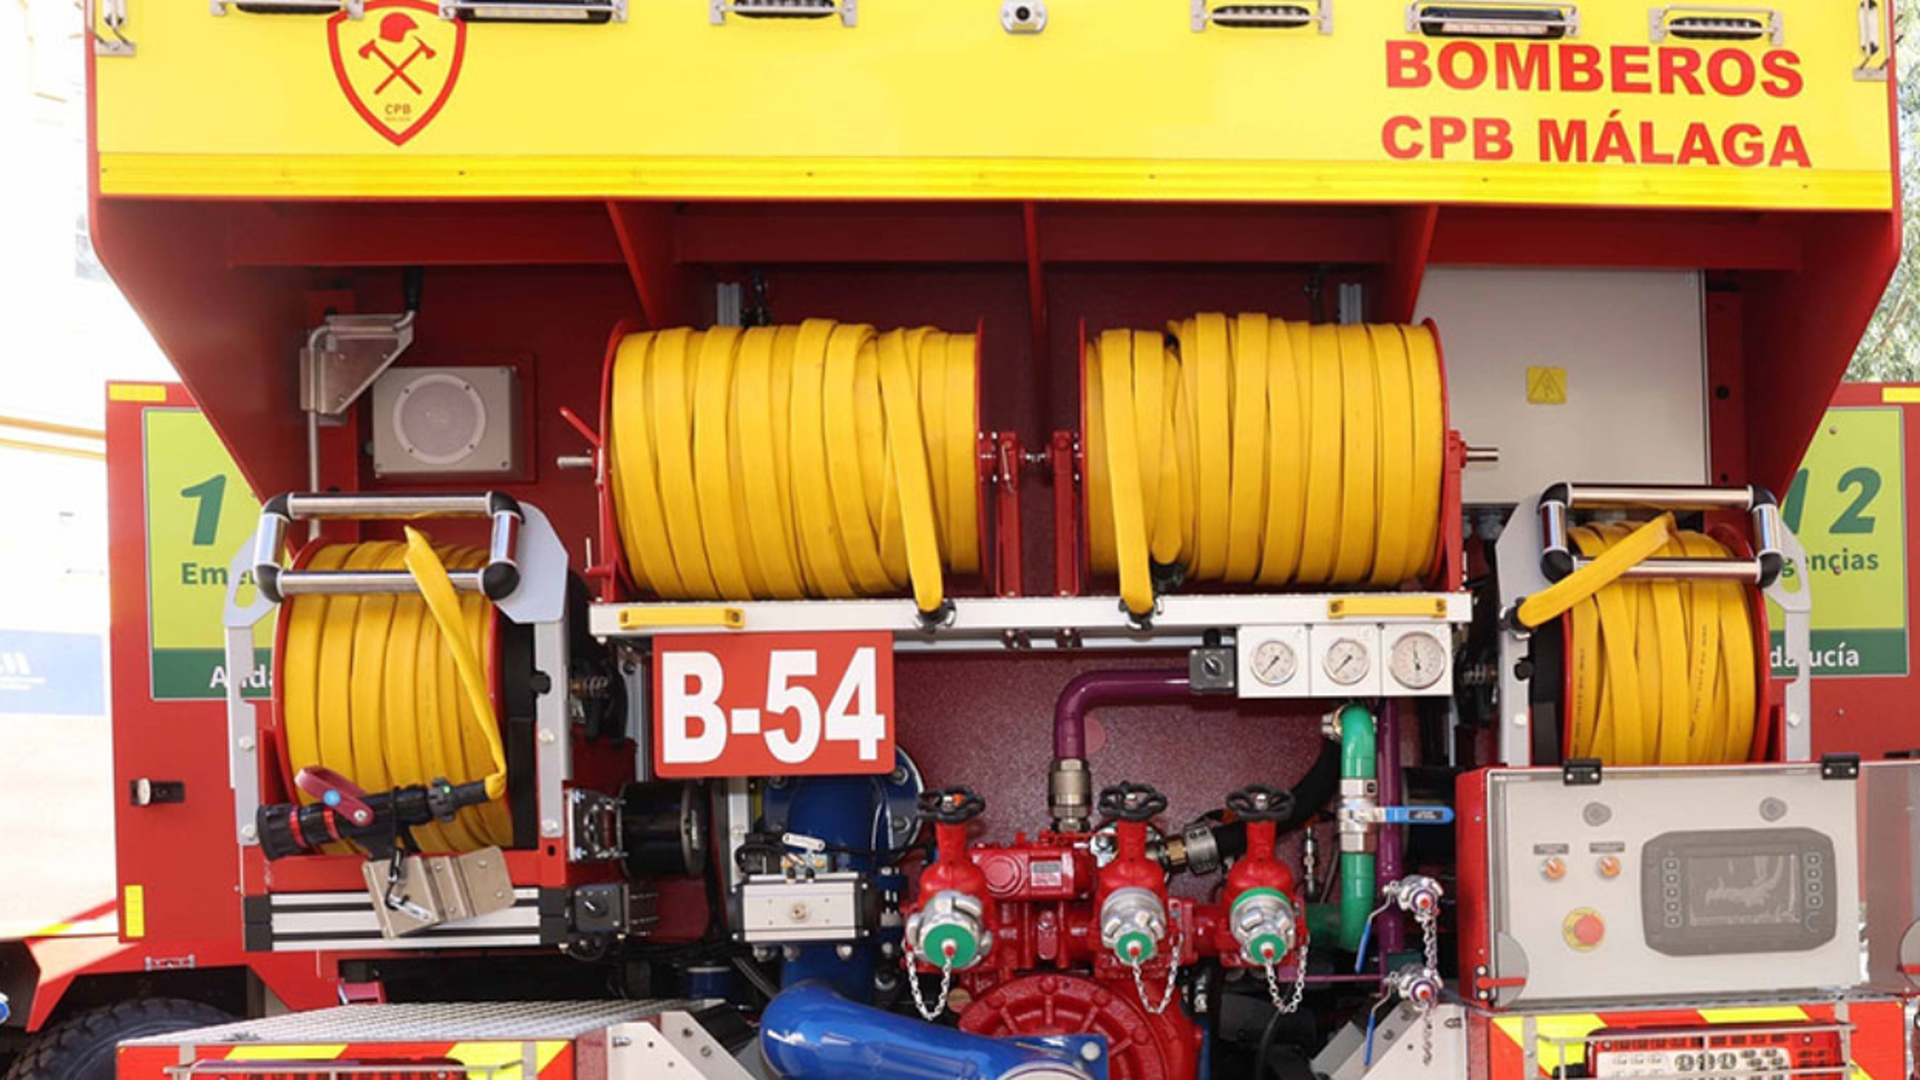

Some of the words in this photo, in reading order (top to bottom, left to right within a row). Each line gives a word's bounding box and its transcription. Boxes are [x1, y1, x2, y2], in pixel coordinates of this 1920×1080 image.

[1386, 40, 1804, 98] BOMBEROS
[1381, 115, 1514, 160] CPB
[1538, 109, 1812, 168] MÁLAGA
[1782, 547, 1878, 578] gncias
[662, 647, 886, 764] B-54
